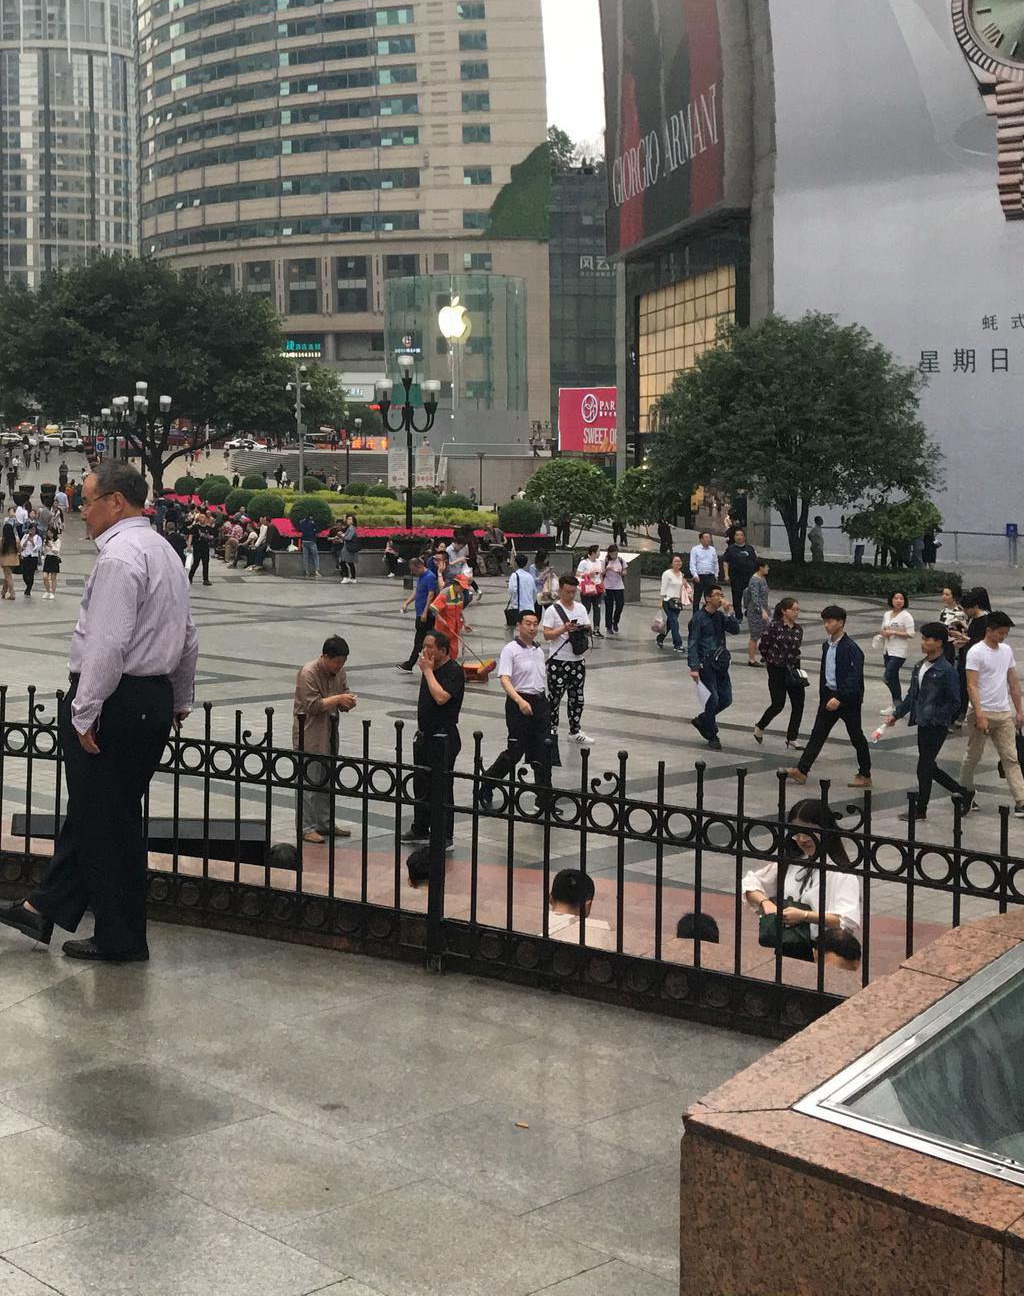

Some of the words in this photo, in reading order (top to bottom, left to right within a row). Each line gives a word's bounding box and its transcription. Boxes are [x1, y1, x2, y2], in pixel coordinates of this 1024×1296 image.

[613, 129, 660, 206] GIORGIO
[663, 83, 719, 177] ARMANI
[580, 255, 617, 270] 风云
[918, 348, 1008, 373] 星期日
[583, 427, 608, 445] SWEET
